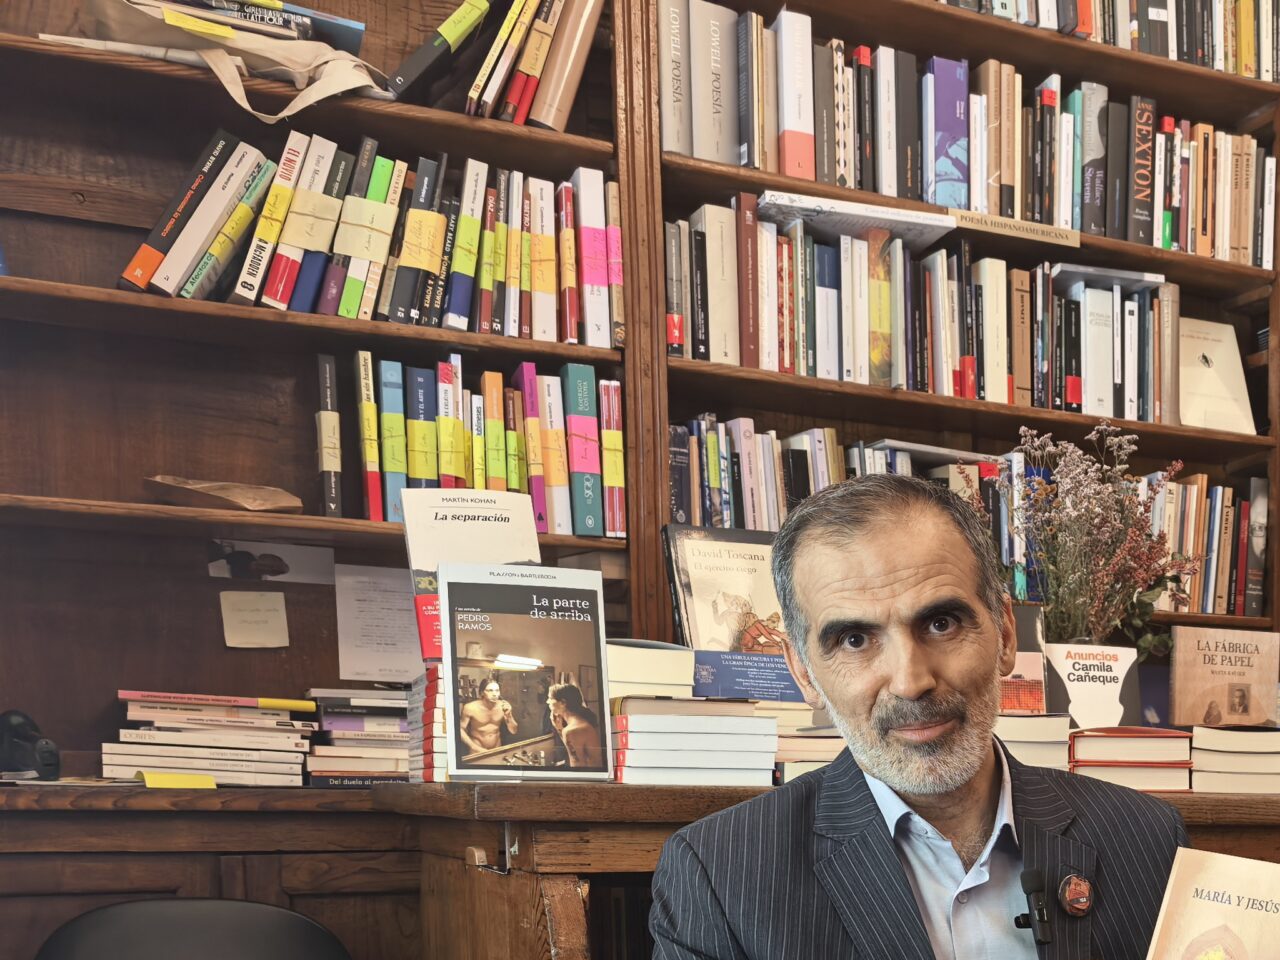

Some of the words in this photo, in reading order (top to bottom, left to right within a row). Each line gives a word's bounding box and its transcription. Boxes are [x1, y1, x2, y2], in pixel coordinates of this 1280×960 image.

[670, 7, 681, 60] LOWELL
[710, 20, 721, 69] LOWELL
[671, 59, 682, 103] POESÍA
[711, 67, 721, 115] POESÍA
[213, 140, 226, 156] DAVID
[287, 148, 301, 157] EL
[1134, 109, 1153, 202] SEXTON
[202, 155, 215, 173] BYRNE
[278, 156, 297, 181] NOVIO
[1084, 167, 1093, 203] Stevens
[1096, 170, 1104, 206] Wallace
[960, 213, 988, 227] POESÍA
[990, 219, 1070, 241] HISPANOAMERICANA
[246, 244, 266, 278] McFADDEN
[189, 261, 211, 287] Afectos
[434, 286, 442, 309] POWER
[470, 497, 497, 505] KOHAN
[433, 512, 448, 522] La
[451, 513, 510, 523] separación
[692, 548, 722, 559] David
[727, 551, 765, 561] Toscana
[533, 595, 549, 606] La
[553, 598, 590, 610] parte
[457, 614, 490, 622] PEDRO
[530, 609, 548, 619] de
[550, 609, 591, 622] arriba
[458, 623, 492, 631] RAMOS
[1197, 640, 1212, 652] LA
[1215, 638, 1260, 654] FÁBRICA
[1065, 650, 1118, 662] Anuncios
[1203, 654, 1217, 665] DE
[1220, 655, 1253, 667] PAPEL
[1072, 662, 1113, 673] Camila
[1067, 672, 1119, 685] Cañeque
[329, 778, 341, 786] Del
[343, 778, 363, 786] duelo
[1192, 887, 1232, 905] MARÍA
[1236, 896, 1245, 907] Y
[1245, 898, 1280, 914] JESÚS
